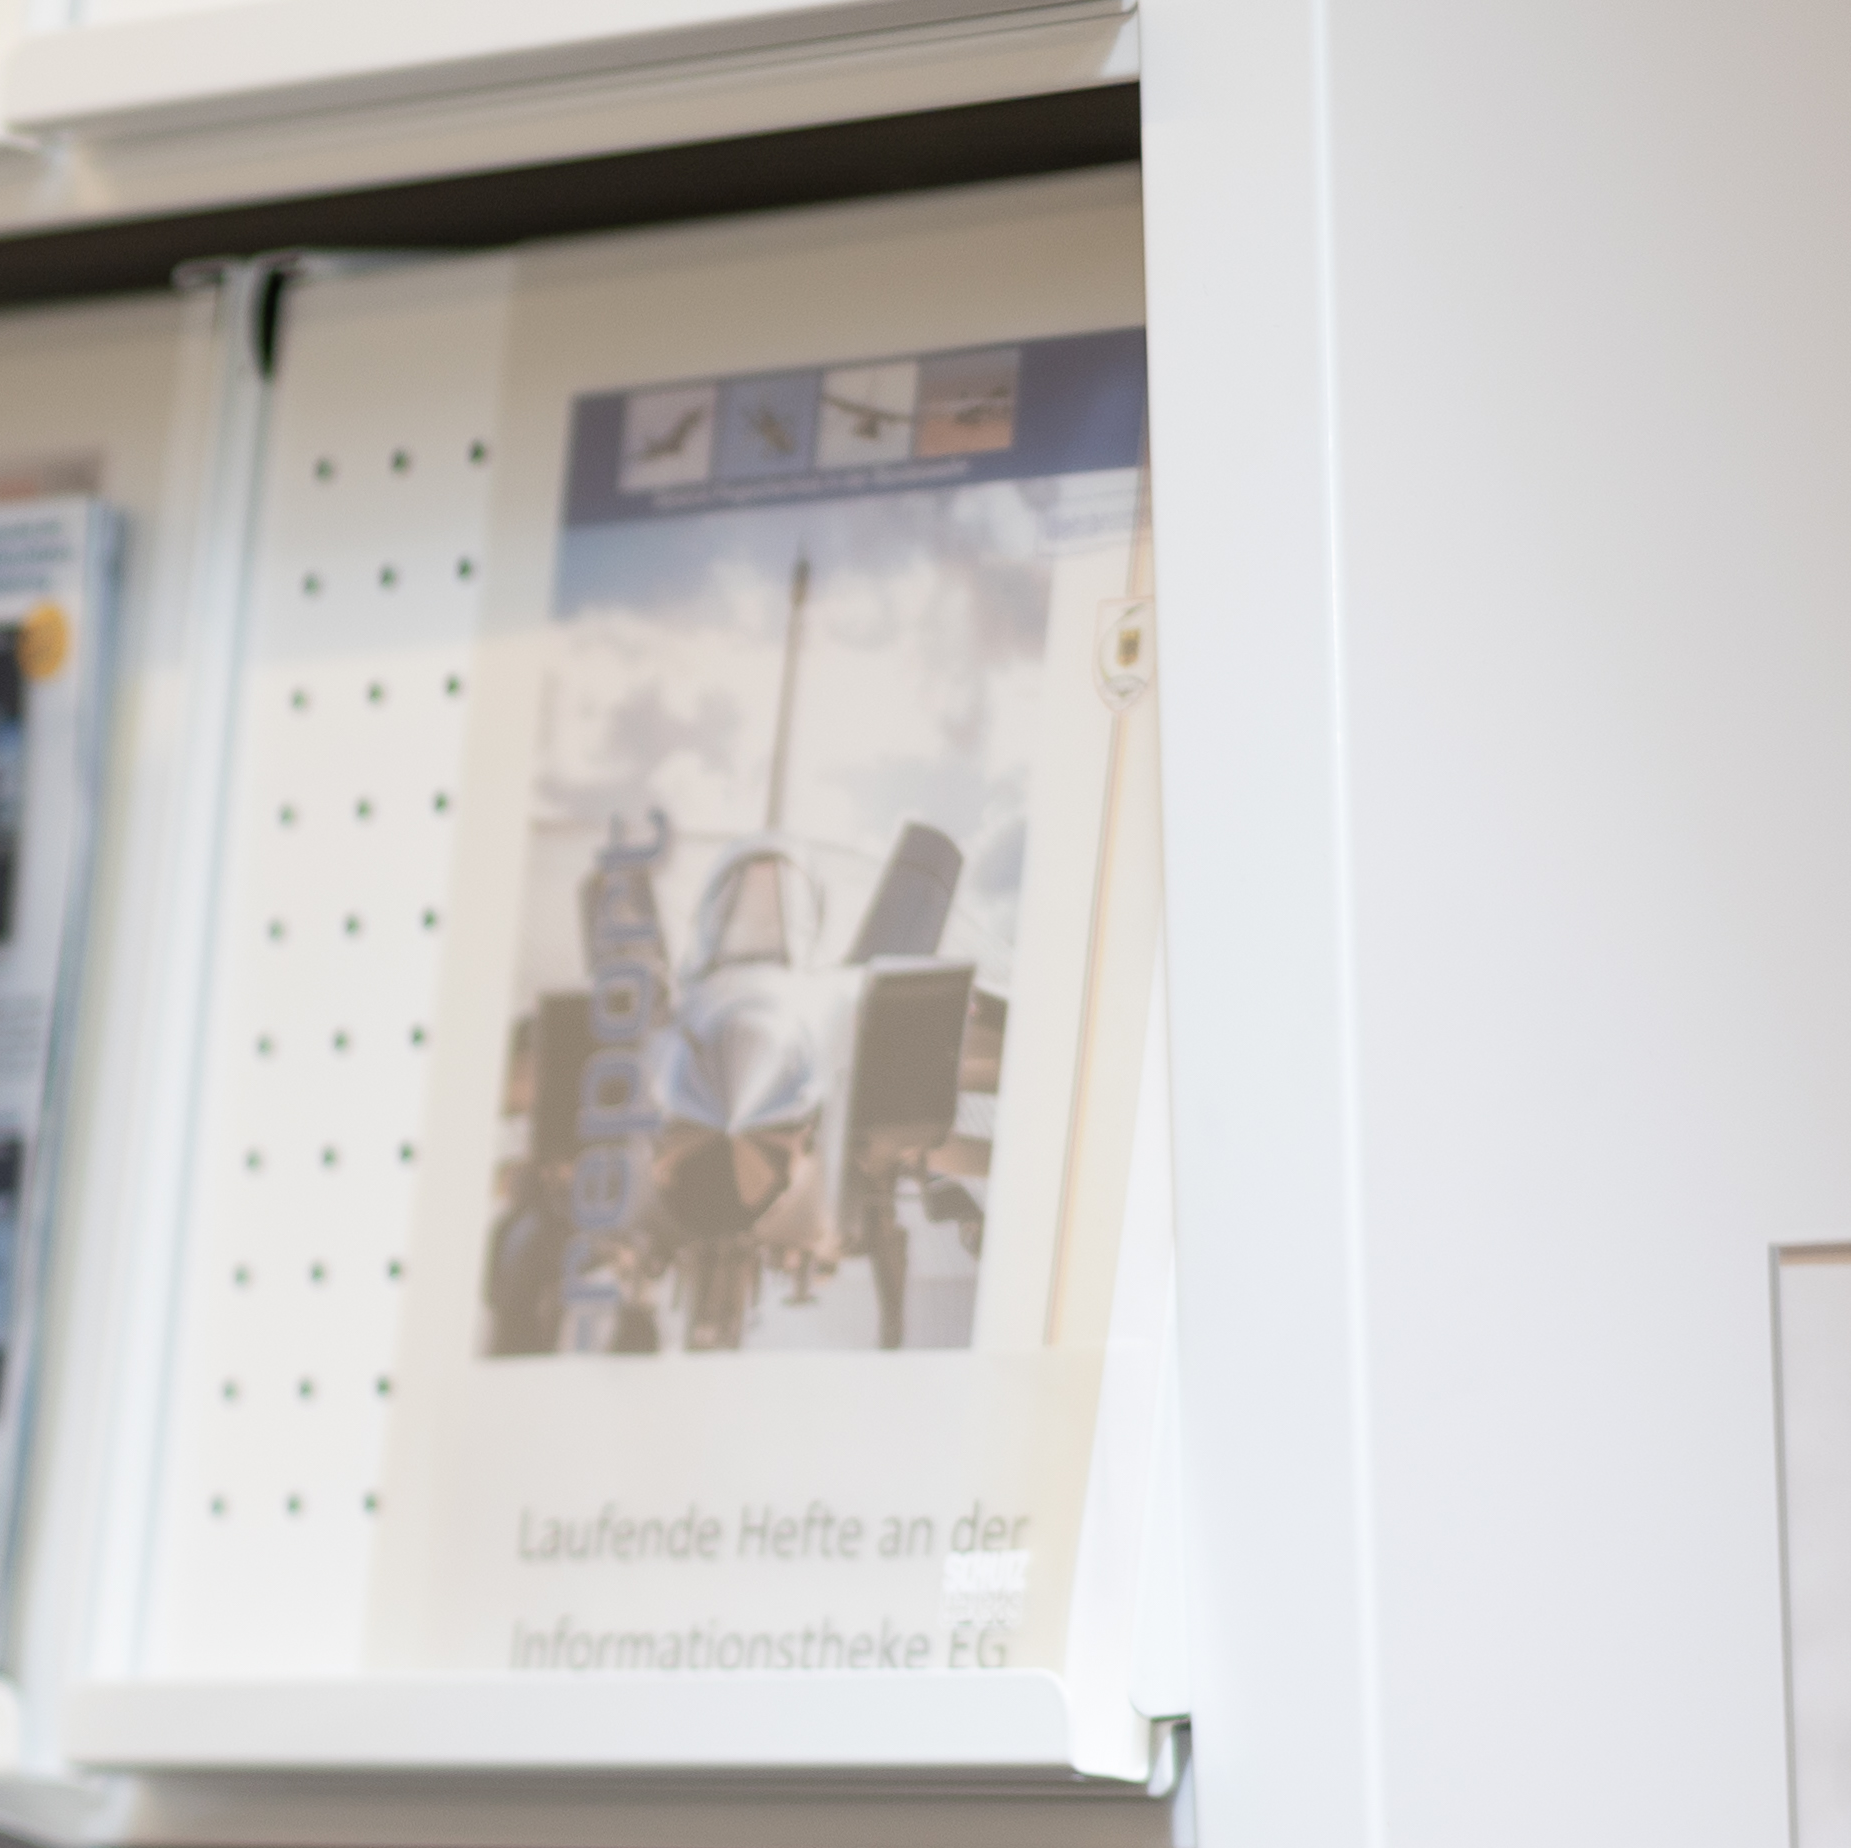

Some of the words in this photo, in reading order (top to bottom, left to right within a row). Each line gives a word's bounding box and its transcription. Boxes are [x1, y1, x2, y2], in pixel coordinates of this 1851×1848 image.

[515, 1504, 722, 1563] Laufende
[735, 1501, 868, 1561] Hefte
[883, 1514, 935, 1559] an
[950, 1499, 1032, 1553] der
[509, 1616, 931, 1670] Informationstheke
[947, 1624, 1007, 1670] EG
